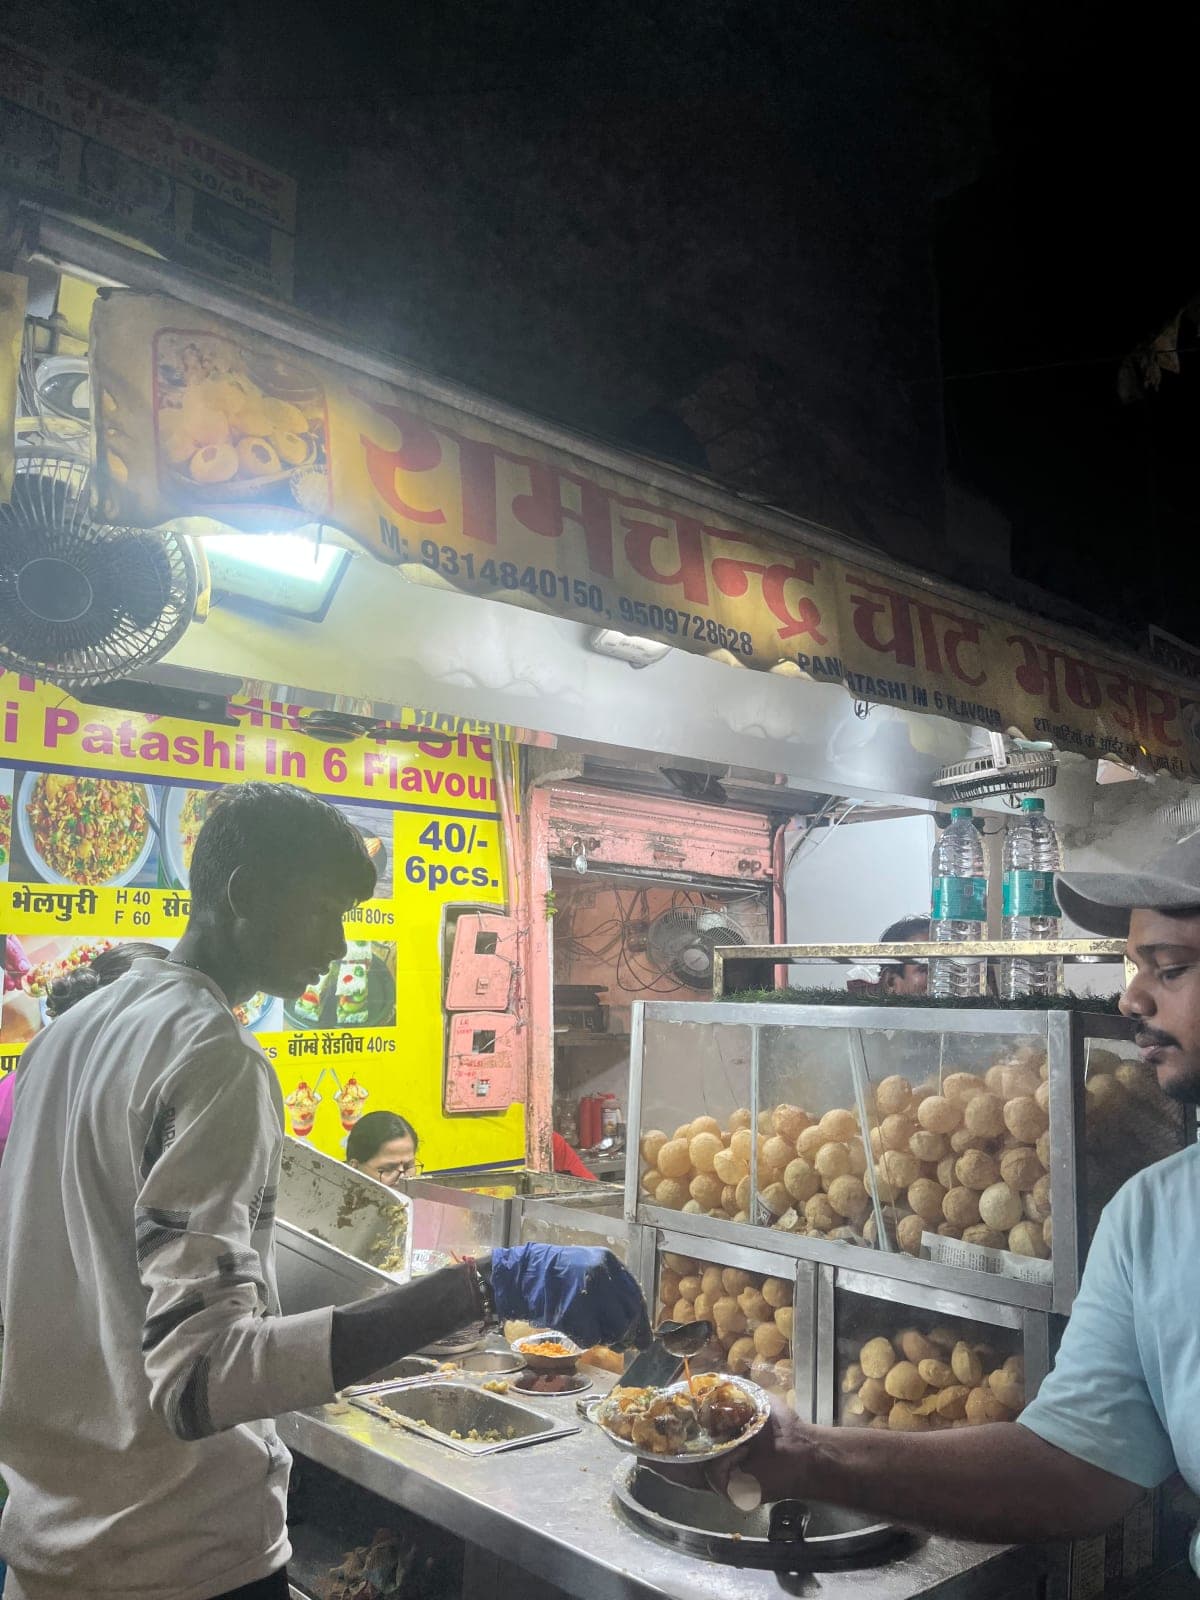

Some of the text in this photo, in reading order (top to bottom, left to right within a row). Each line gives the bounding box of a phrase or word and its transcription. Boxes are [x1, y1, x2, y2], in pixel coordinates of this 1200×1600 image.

[352, 386, 1183, 748] रामचन्द्र चाट भण्डार
[619, 598, 754, 656] 9509728628
[913, 683, 928, 708] IN
[933, 690, 943, 710] 6
[44, 706, 245, 771] Patashi
[265, 738, 306, 778] In
[323, 746, 348, 783] 6
[419, 821, 488, 854] 40/-
[405, 856, 499, 891] 6pcs.
[12, 885, 98, 921] भेलपुरी
[117, 889, 128, 905] H
[132, 890, 151, 905] 40
[115, 910, 151, 926] F 60
[366, 908, 395, 925] 80rs
[322, 1032, 364, 1055] सैंडविच
[366, 1036, 396, 1053] 40rs
